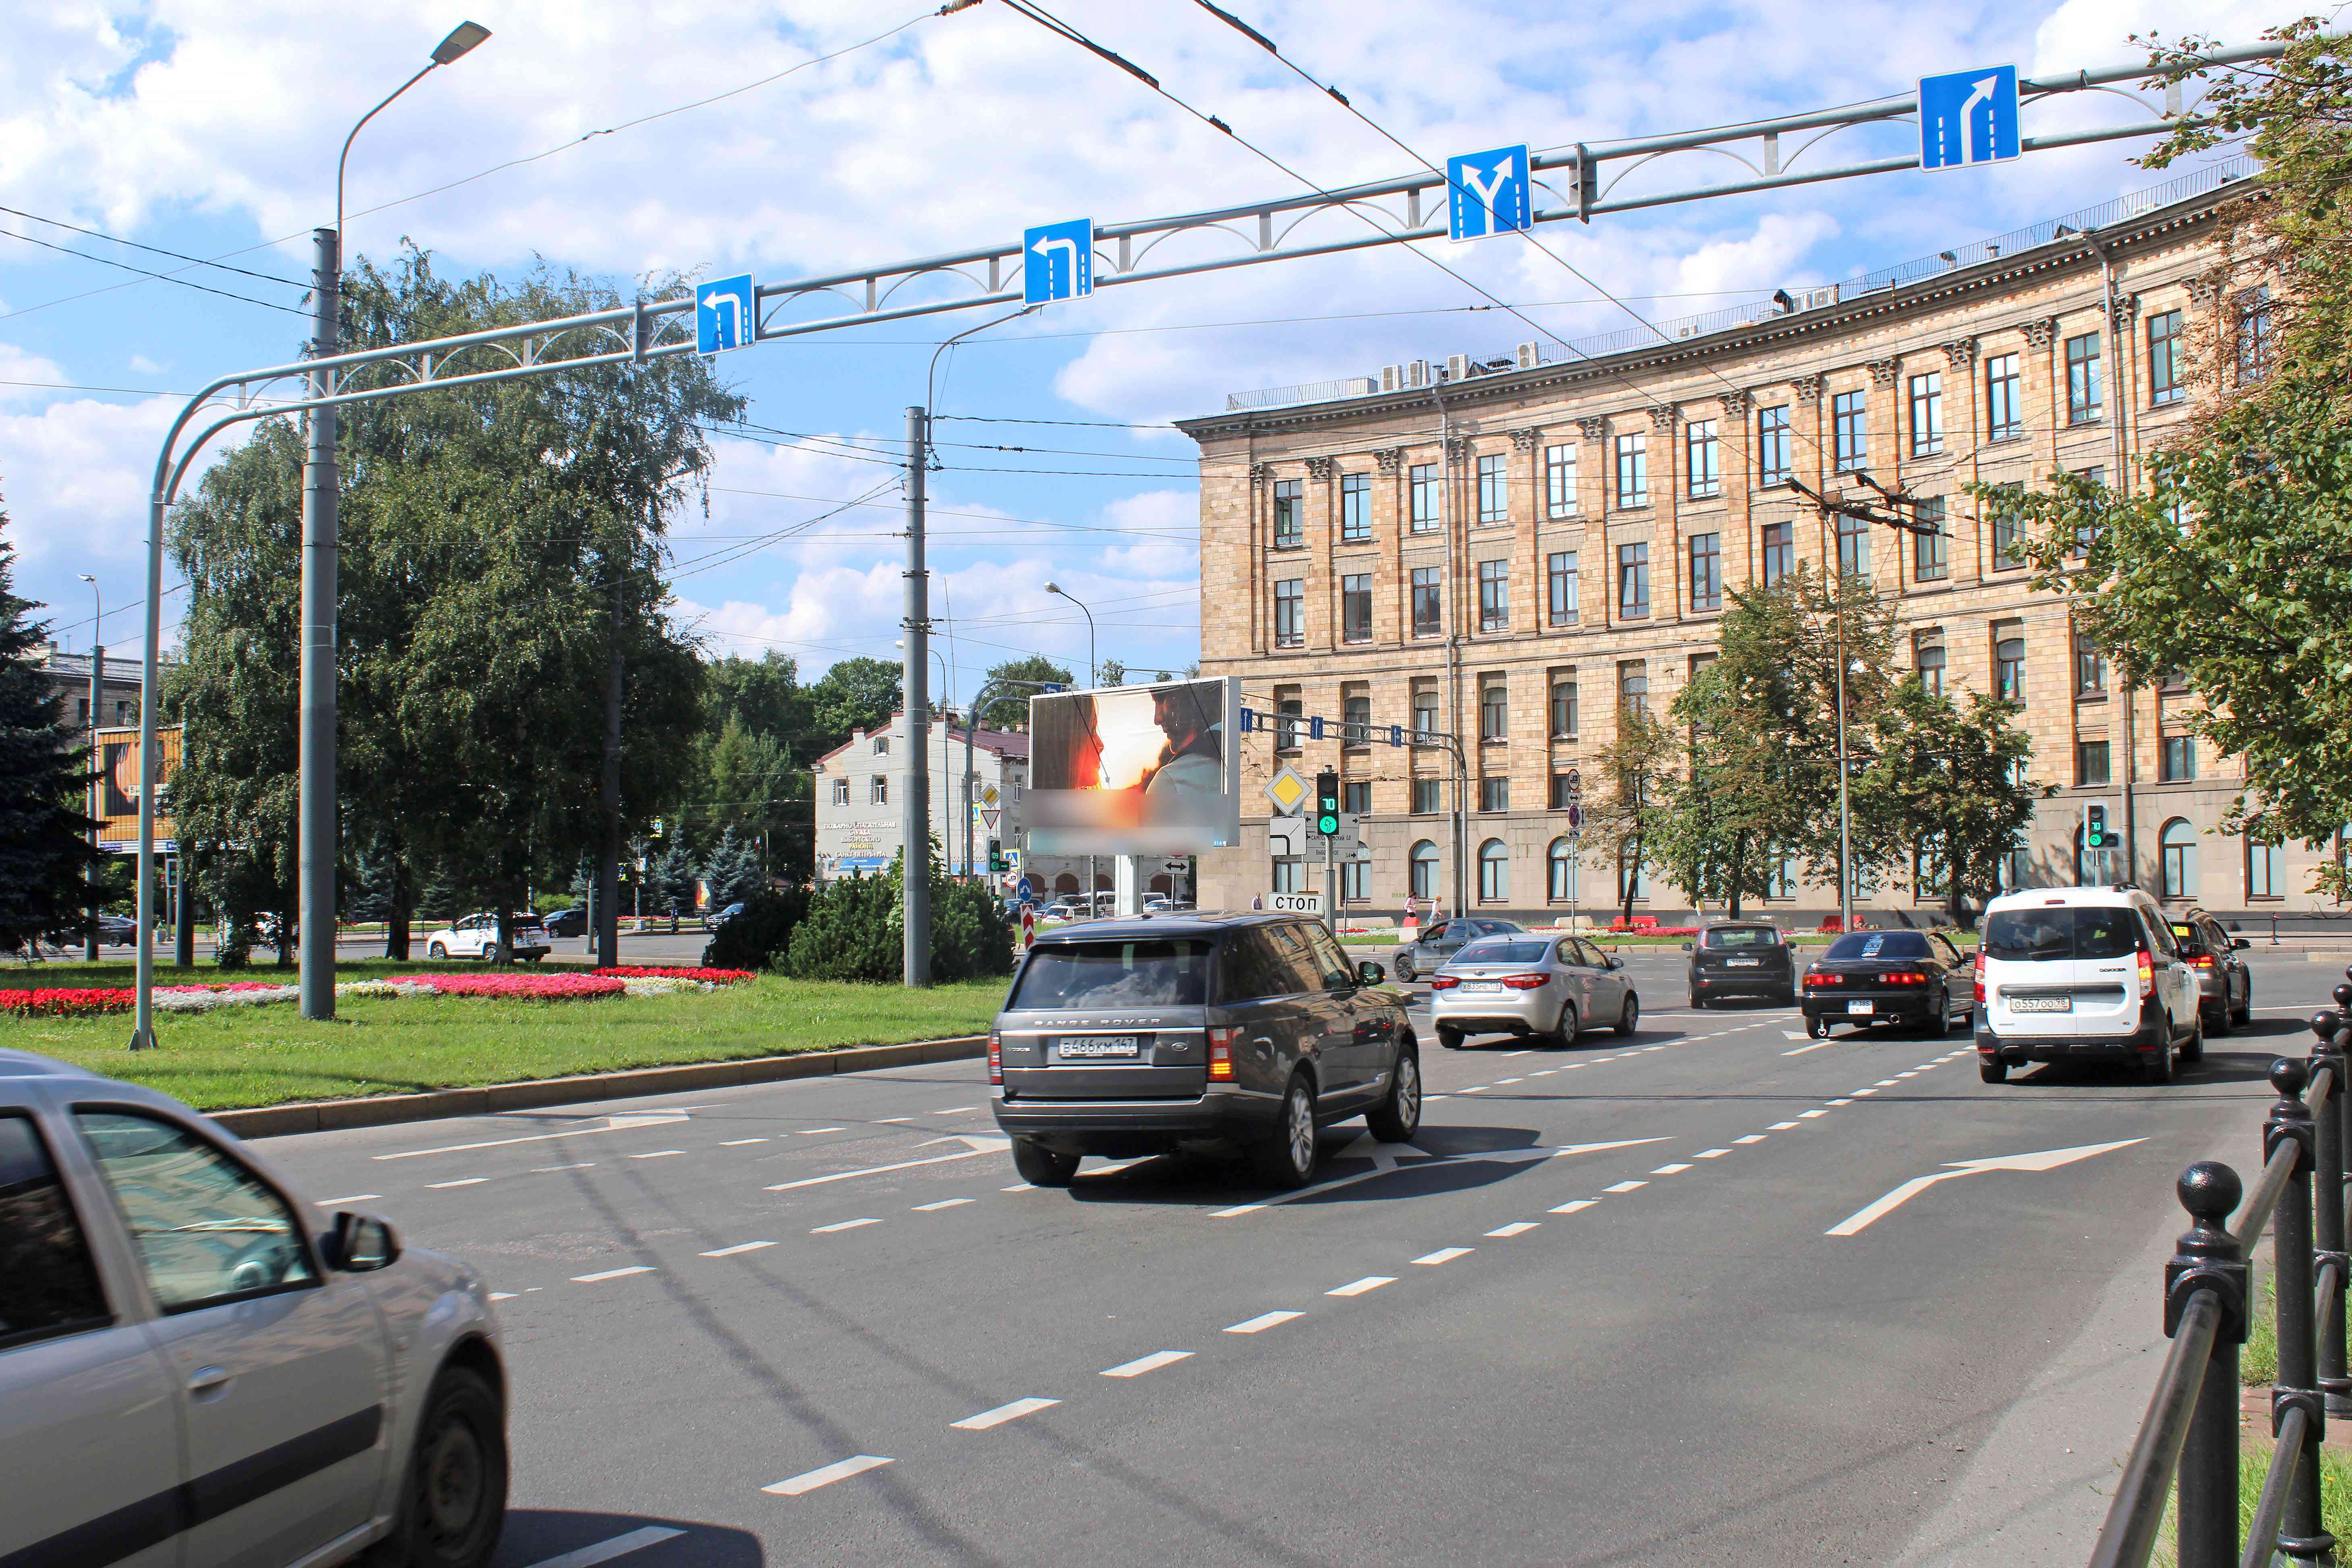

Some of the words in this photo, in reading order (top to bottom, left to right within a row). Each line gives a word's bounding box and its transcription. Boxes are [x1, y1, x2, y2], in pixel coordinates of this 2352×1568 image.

[1322, 798, 1335, 811] 70
[2091, 821, 2101, 831] 70
[1276, 896, 1317, 911] СТОП
[2015, 999, 2054, 1008] О557ОО
[1064, 1039, 1113, 1053] В466КМ
[1115, 1037, 1133, 1048] 147
